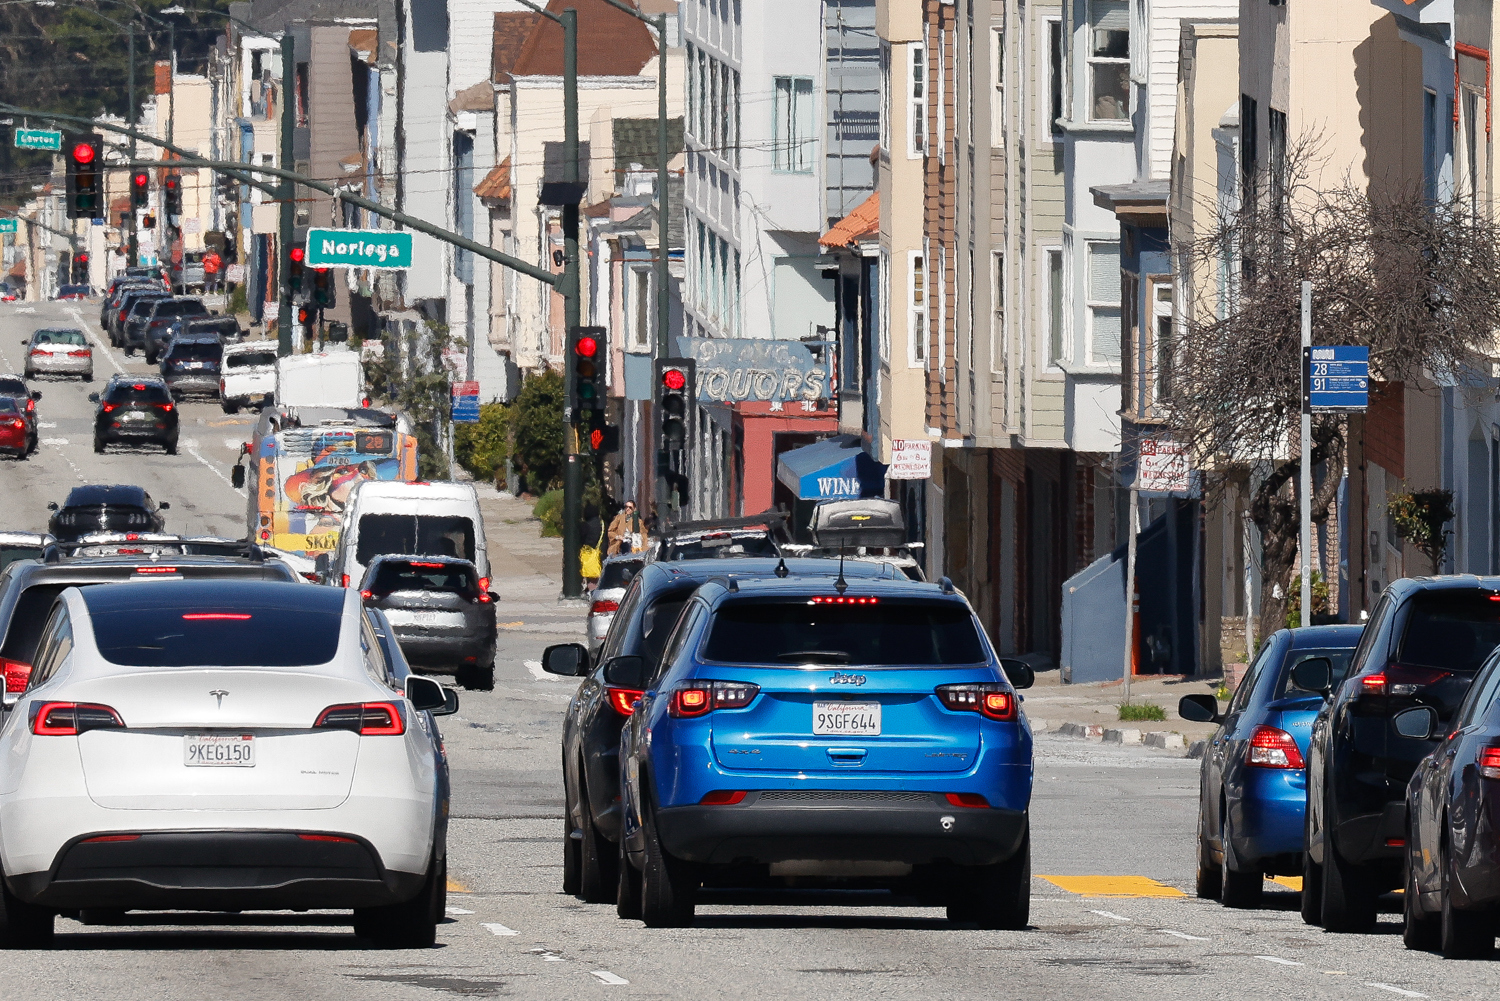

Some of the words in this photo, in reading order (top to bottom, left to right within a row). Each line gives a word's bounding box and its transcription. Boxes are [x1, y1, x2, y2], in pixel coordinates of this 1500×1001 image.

[322, 239, 400, 262] Noriega
[1314, 363, 1328, 376] 28
[696, 367, 826, 400] IQUORS
[1313, 378, 1326, 390] 91
[364, 436, 384, 449] 28
[829, 672, 867, 686] Jeep
[827, 703, 868, 713] California
[818, 713, 876, 729] 9SGF644
[199, 735, 242, 745] California
[189, 744, 251, 761] 9KEG150
